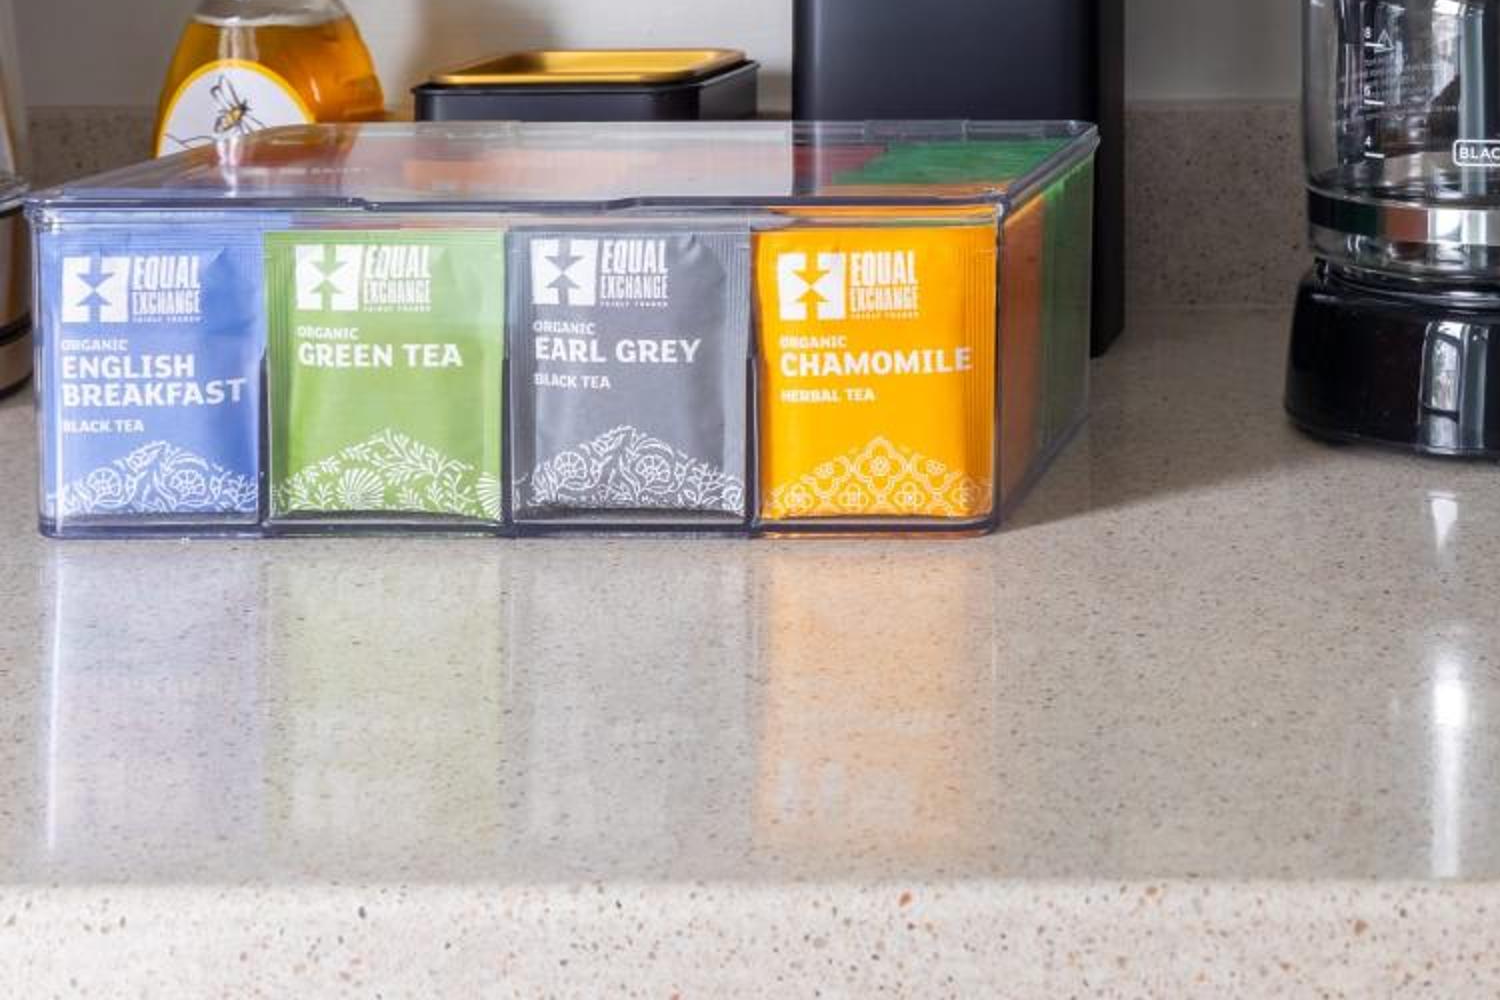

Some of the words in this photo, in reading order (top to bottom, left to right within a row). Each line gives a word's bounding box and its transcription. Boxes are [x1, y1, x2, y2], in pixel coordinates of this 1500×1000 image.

[364, 244, 432, 278] EQUAL
[601, 239, 668, 274] EQUAL
[851, 250, 918, 286] EQUAL
[132, 256, 200, 290] EQUAL
[600, 275, 669, 299] EXCHANGE
[131, 290, 201, 315] EXCHANGE
[296, 325, 359, 340] ORGANIC
[532, 320, 596, 335] ORGANIC
[62, 339, 128, 351] ORGANIC
[534, 335, 607, 363] EARL
[614, 338, 702, 364] GREY
[780, 335, 847, 349] ORGANIC
[62, 354, 195, 379] ENGLISH
[298, 342, 394, 368] GREEN
[402, 343, 464, 368] TEA
[780, 347, 974, 377] CHAMOMILE
[62, 378, 247, 407] BREAKFAST
[533, 372, 578, 388] BLACK
[581, 375, 611, 390] TEA
[781, 388, 841, 402] HERBAL
[846, 387, 876, 402] TEA
[62, 420, 109, 433] BLACK
[114, 419, 145, 433] TEA
